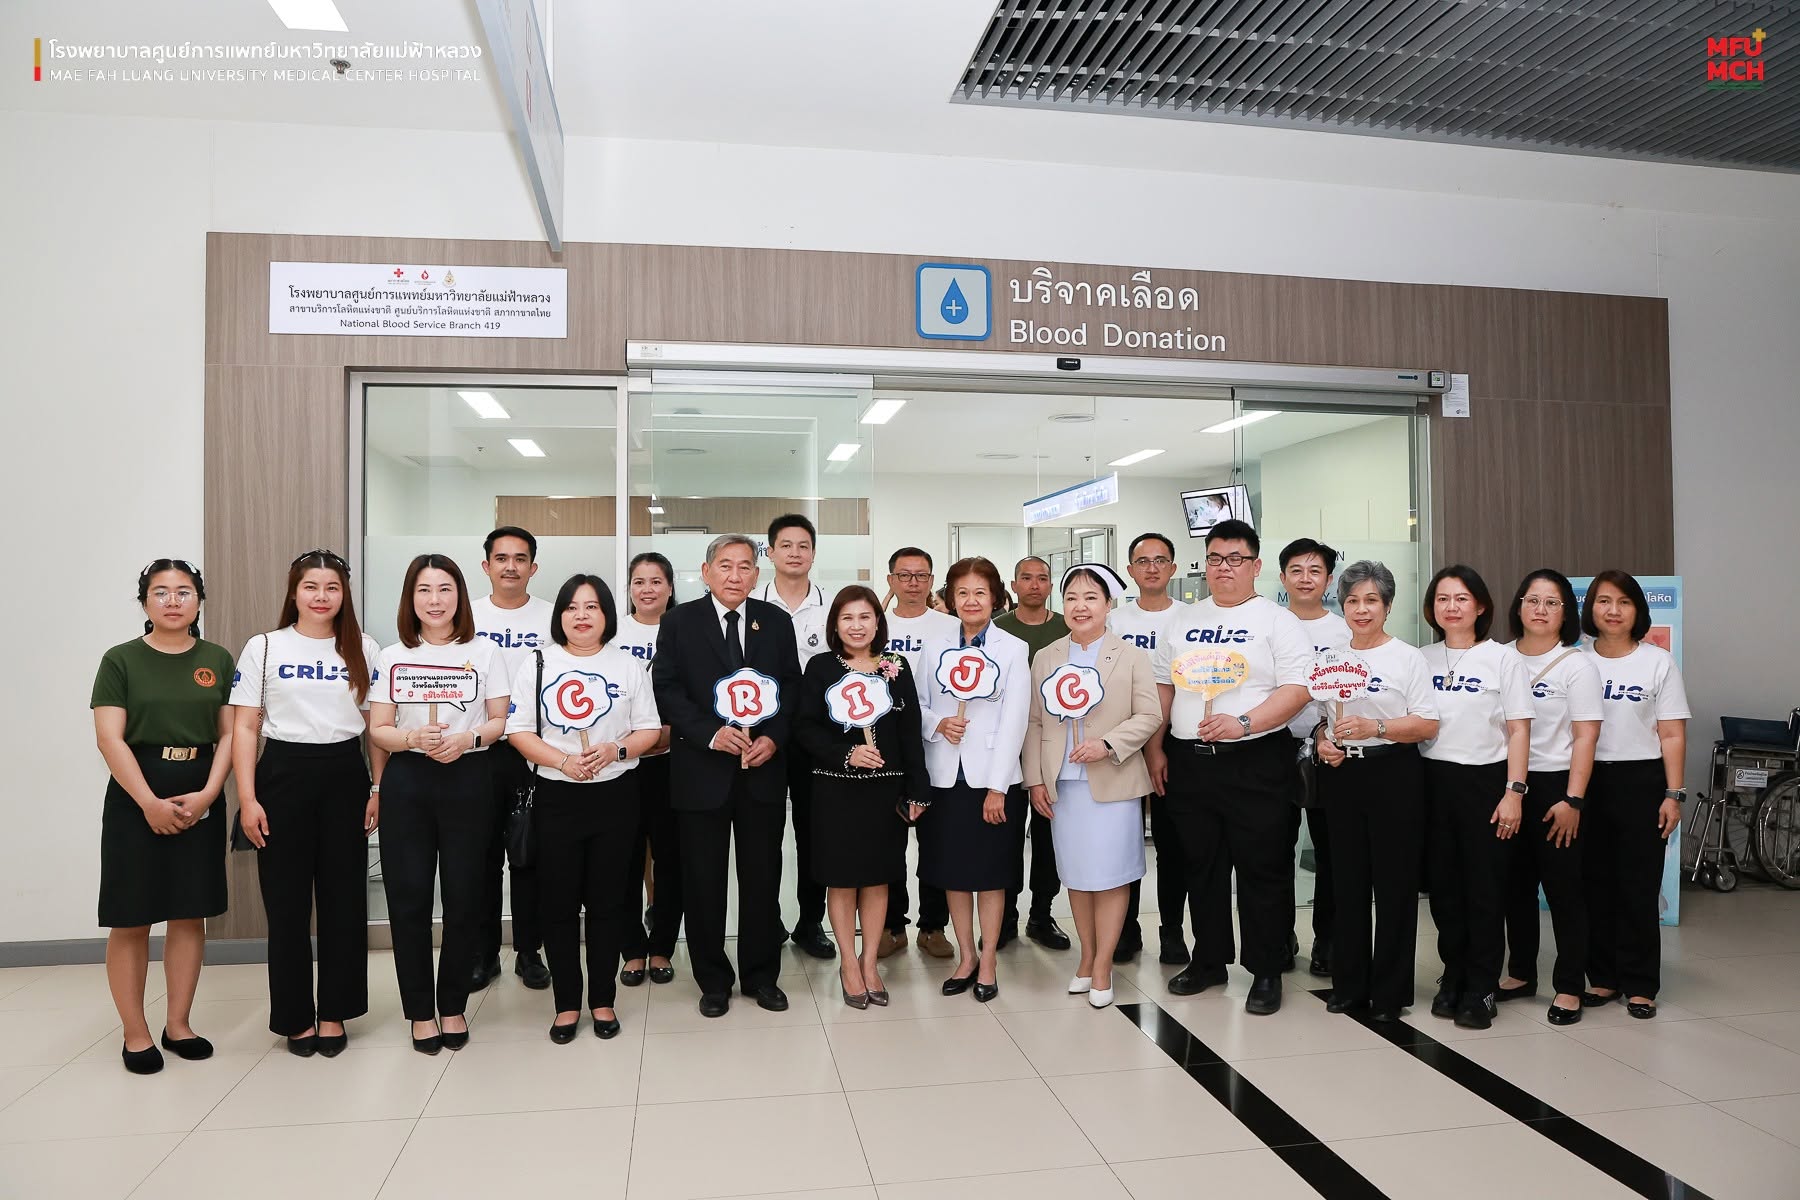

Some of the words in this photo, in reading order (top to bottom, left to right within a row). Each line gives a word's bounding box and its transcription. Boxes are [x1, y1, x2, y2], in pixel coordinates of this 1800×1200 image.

[288, 285, 551, 303] โรงพยาบาลศูนย์การแพทย์มหาวิทยาลัยแม่ฟ้าหลวง
[1009, 266, 1199, 311] บริจาคเลือด
[340, 319, 380, 328] National
[382, 320, 410, 328] Blood
[413, 321, 446, 329] Service
[449, 321, 481, 329] Branch
[484, 322, 501, 330] 419
[1010, 319, 1088, 346] Blood
[1103, 323, 1227, 352] Donation
[950, 655, 985, 692] J
[1055, 672, 1090, 710] C
[557, 679, 594, 720] C
[727, 680, 763, 718] R
[841, 681, 875, 720] I
